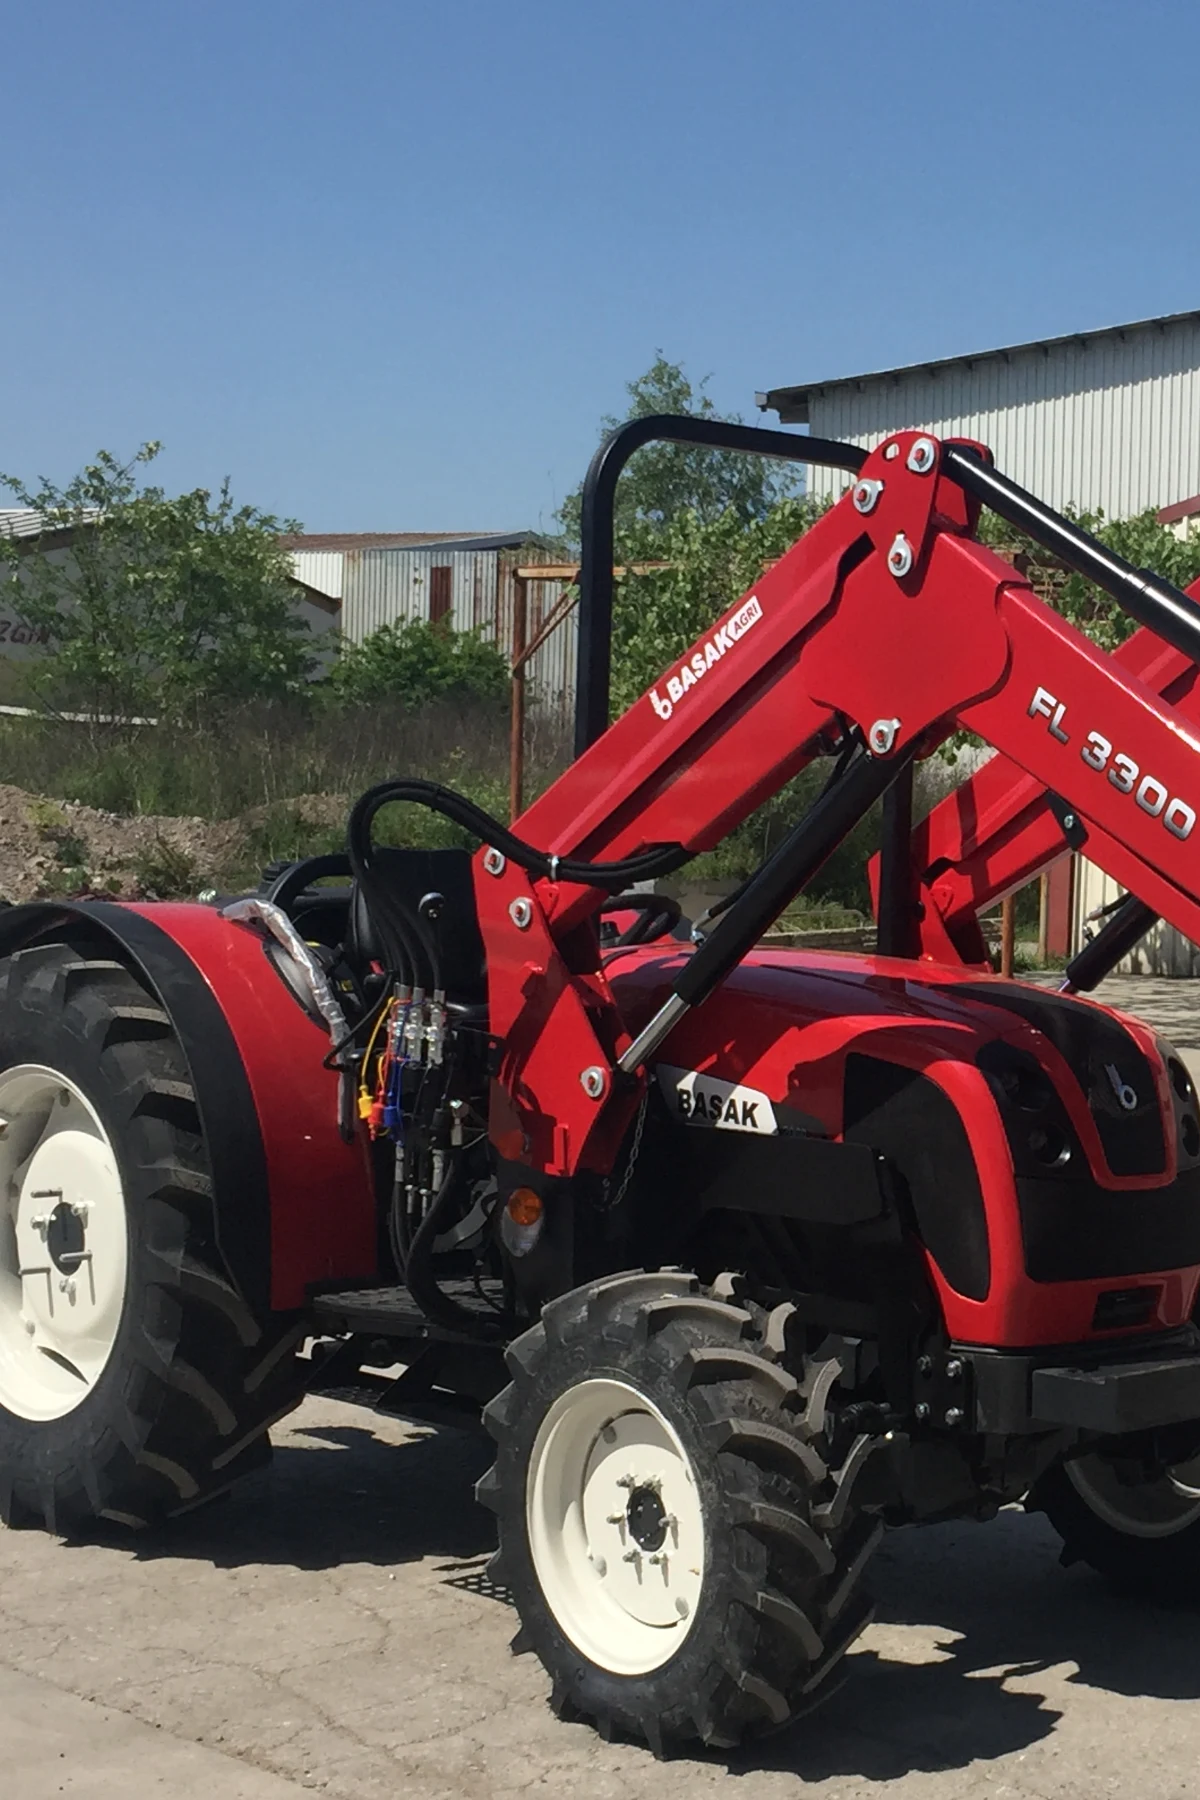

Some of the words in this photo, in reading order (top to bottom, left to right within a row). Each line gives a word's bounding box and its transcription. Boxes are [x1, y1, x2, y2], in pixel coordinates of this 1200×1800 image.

[666, 624, 735, 704] BASAK
[733, 602, 760, 636] AGRI
[1027, 686, 1071, 746] FL
[1080, 730, 1197, 842] 3300
[678, 1087, 760, 1129] BASAK
